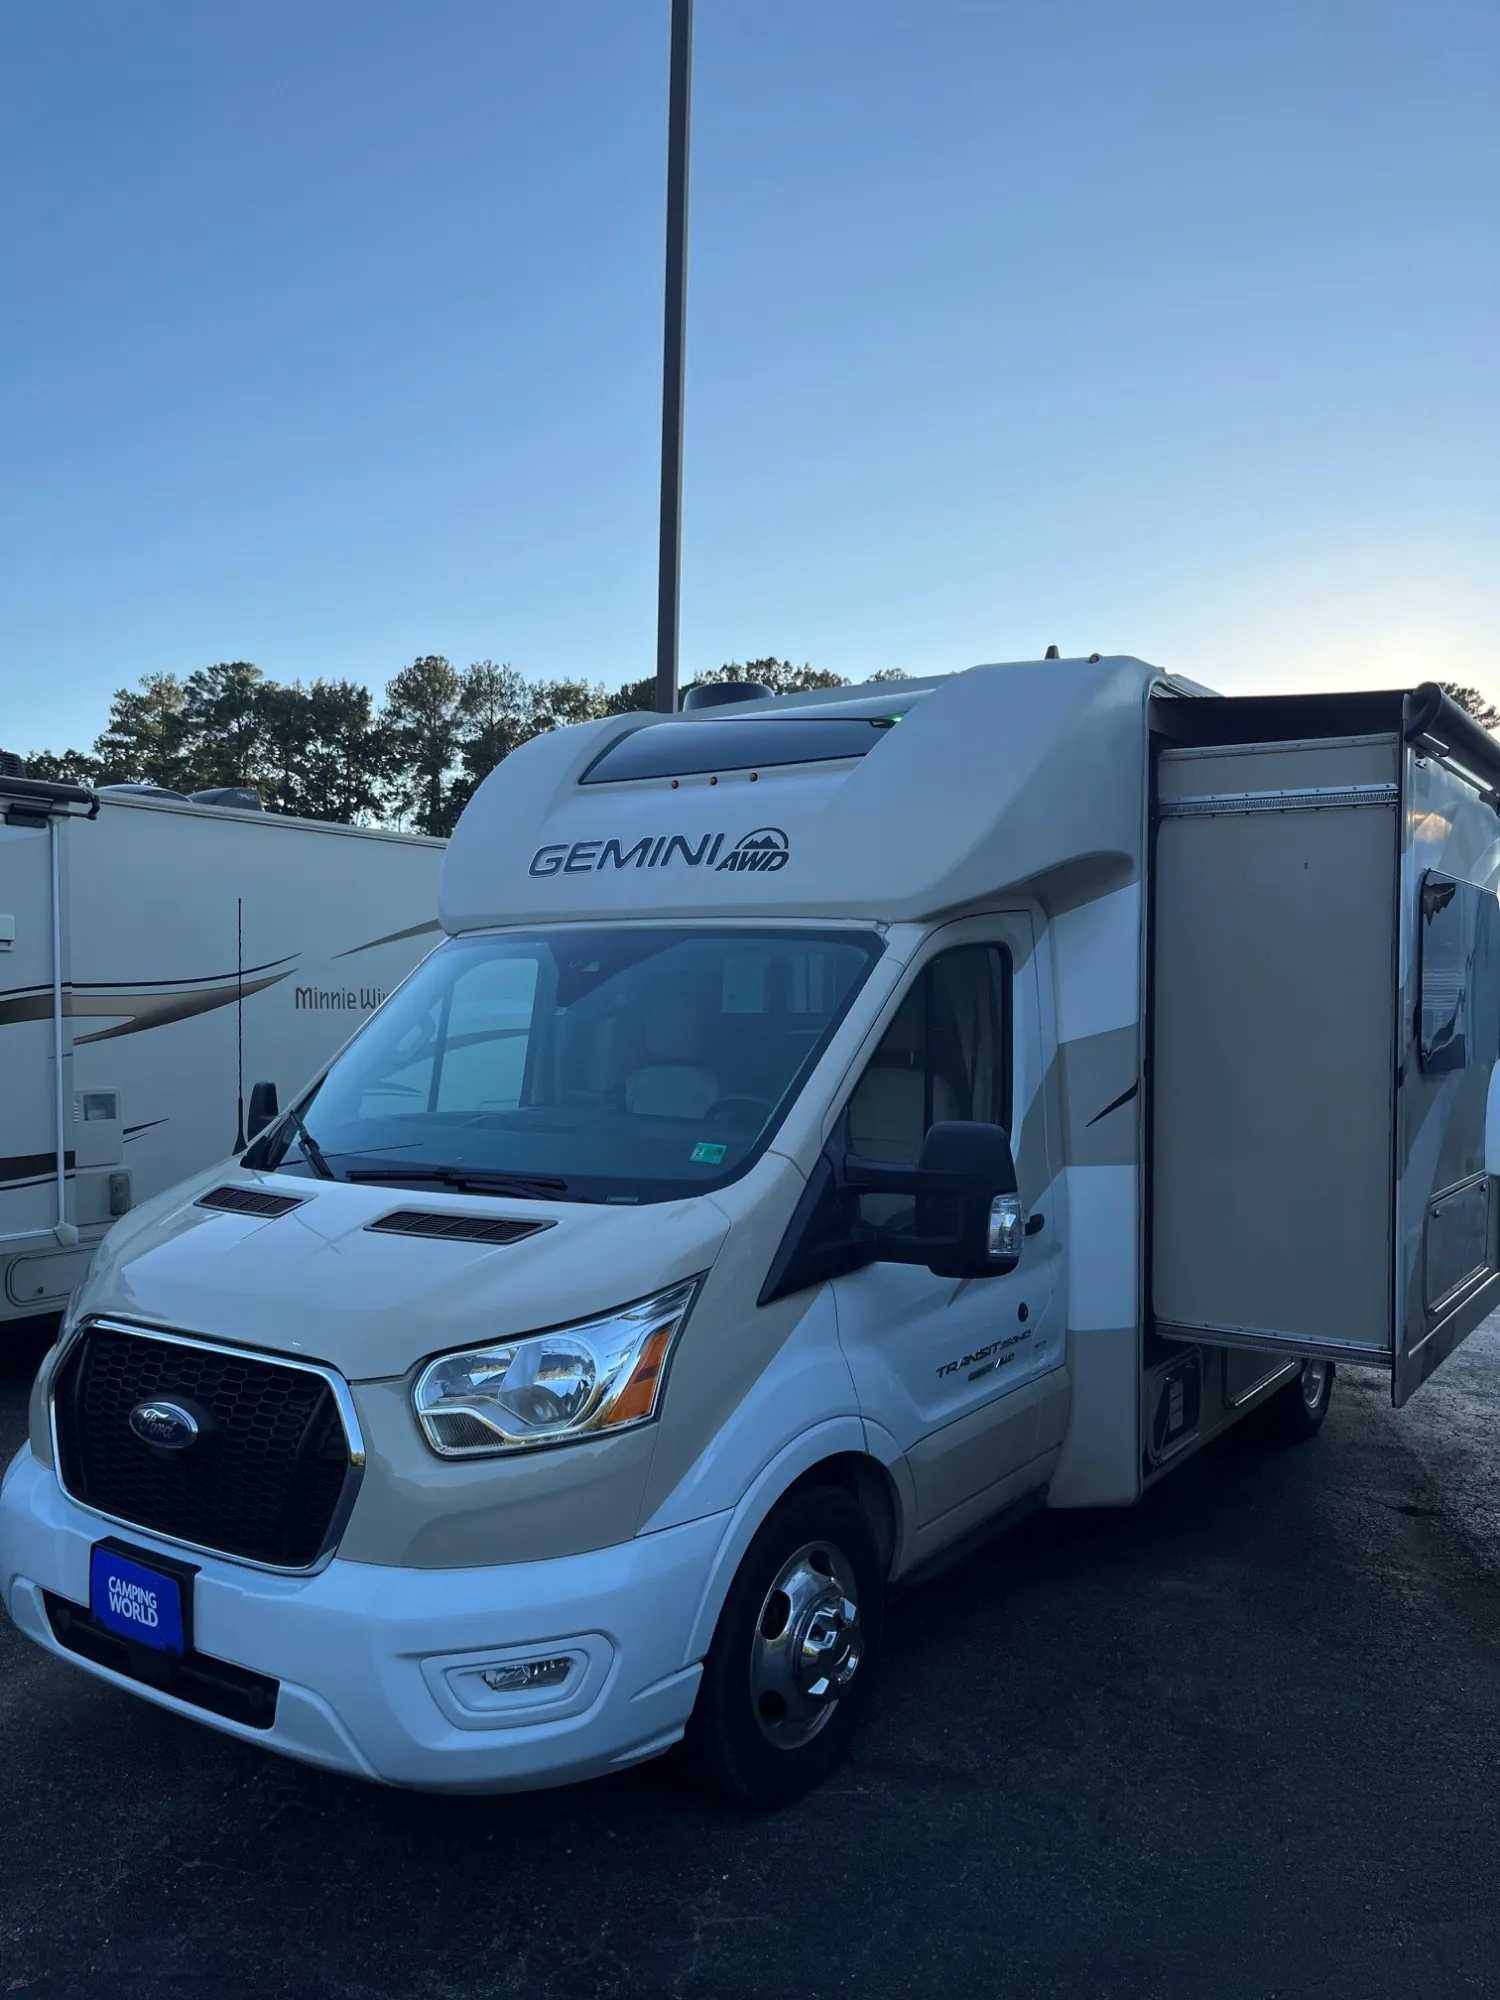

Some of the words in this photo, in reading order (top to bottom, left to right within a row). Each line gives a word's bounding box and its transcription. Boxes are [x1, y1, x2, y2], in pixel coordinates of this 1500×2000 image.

[528, 832, 725, 878] GEMINI
[714, 851, 790, 872] AWD
[295, 986, 357, 1010] Minnie
[935, 1341, 1001, 1379] TRANSIT
[136, 1408, 177, 1440] Ford
[108, 1575, 157, 1610] CAMPING
[108, 1591, 159, 1628] WORLD
